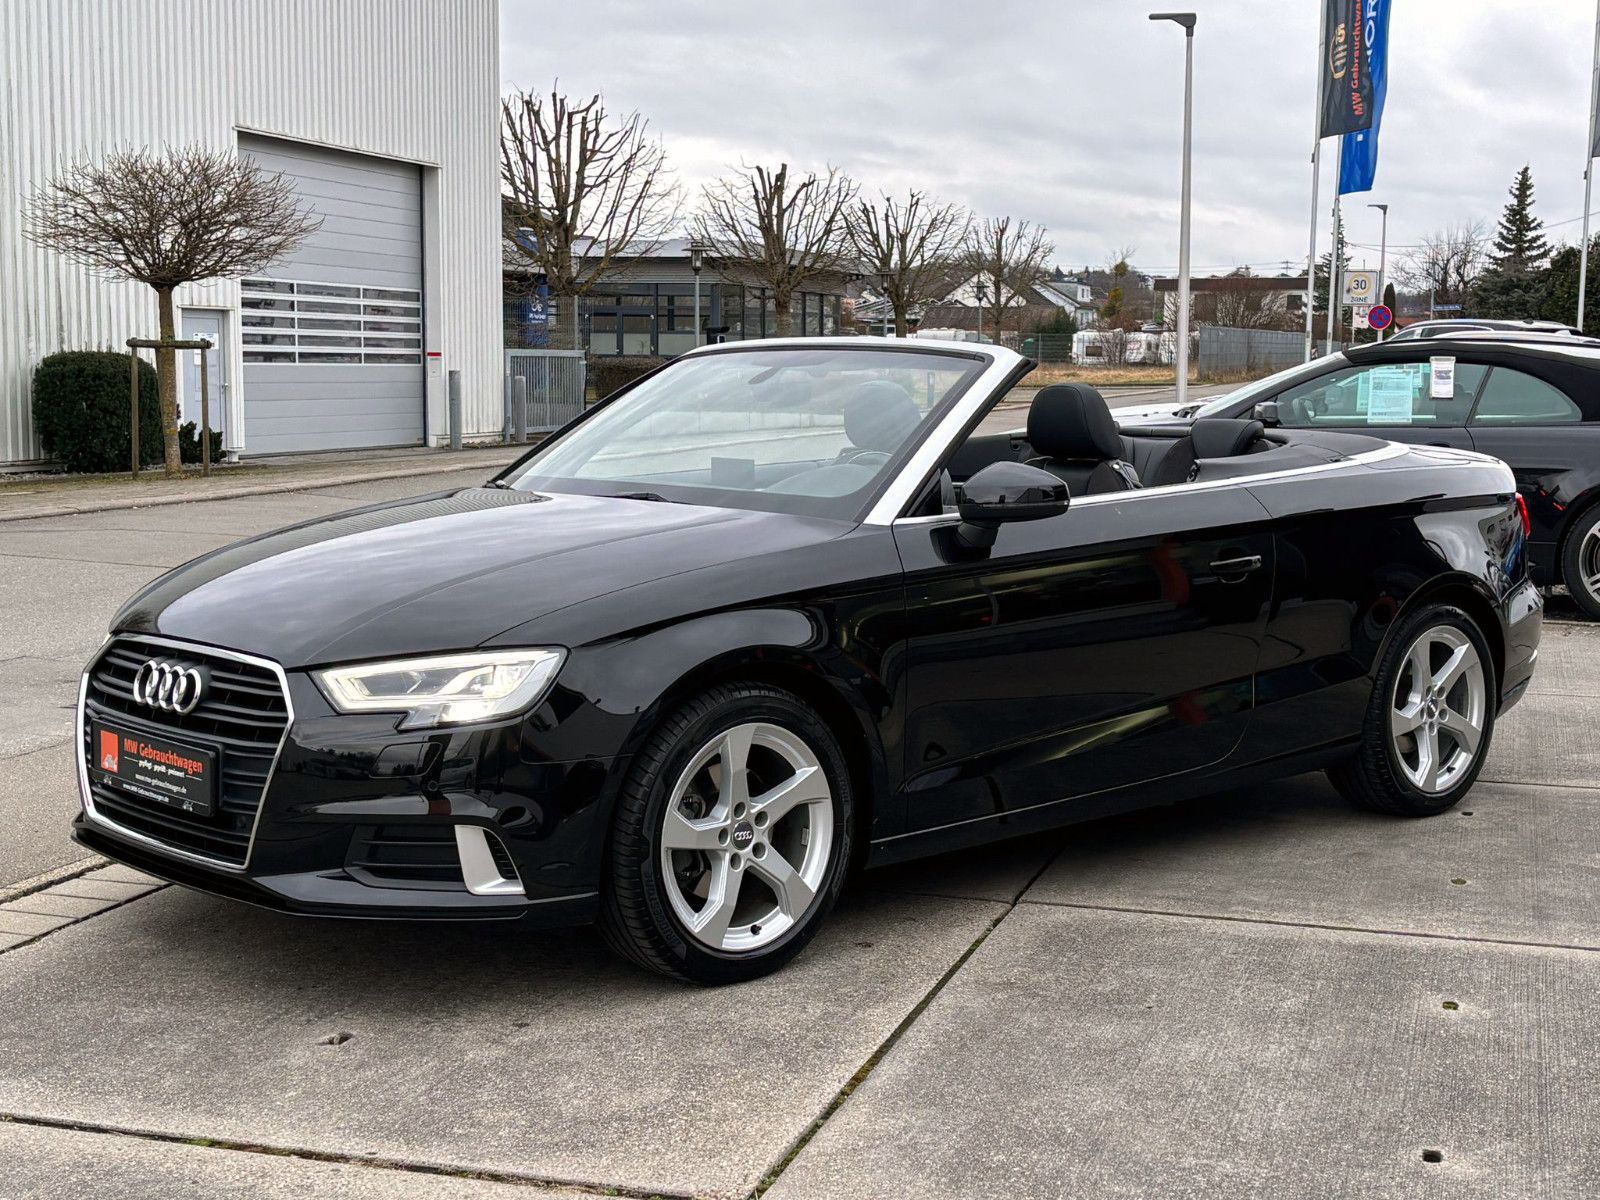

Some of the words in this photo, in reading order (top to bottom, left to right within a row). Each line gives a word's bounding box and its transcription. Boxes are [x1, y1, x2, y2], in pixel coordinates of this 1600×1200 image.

[1351, 0, 1361, 89] Gebrauchtwa
[1351, 92, 1364, 116] MW
[1353, 279, 1367, 290] 30
[123, 738, 138, 754] MW
[138, 743, 203, 776] Gebrauchtwagen
